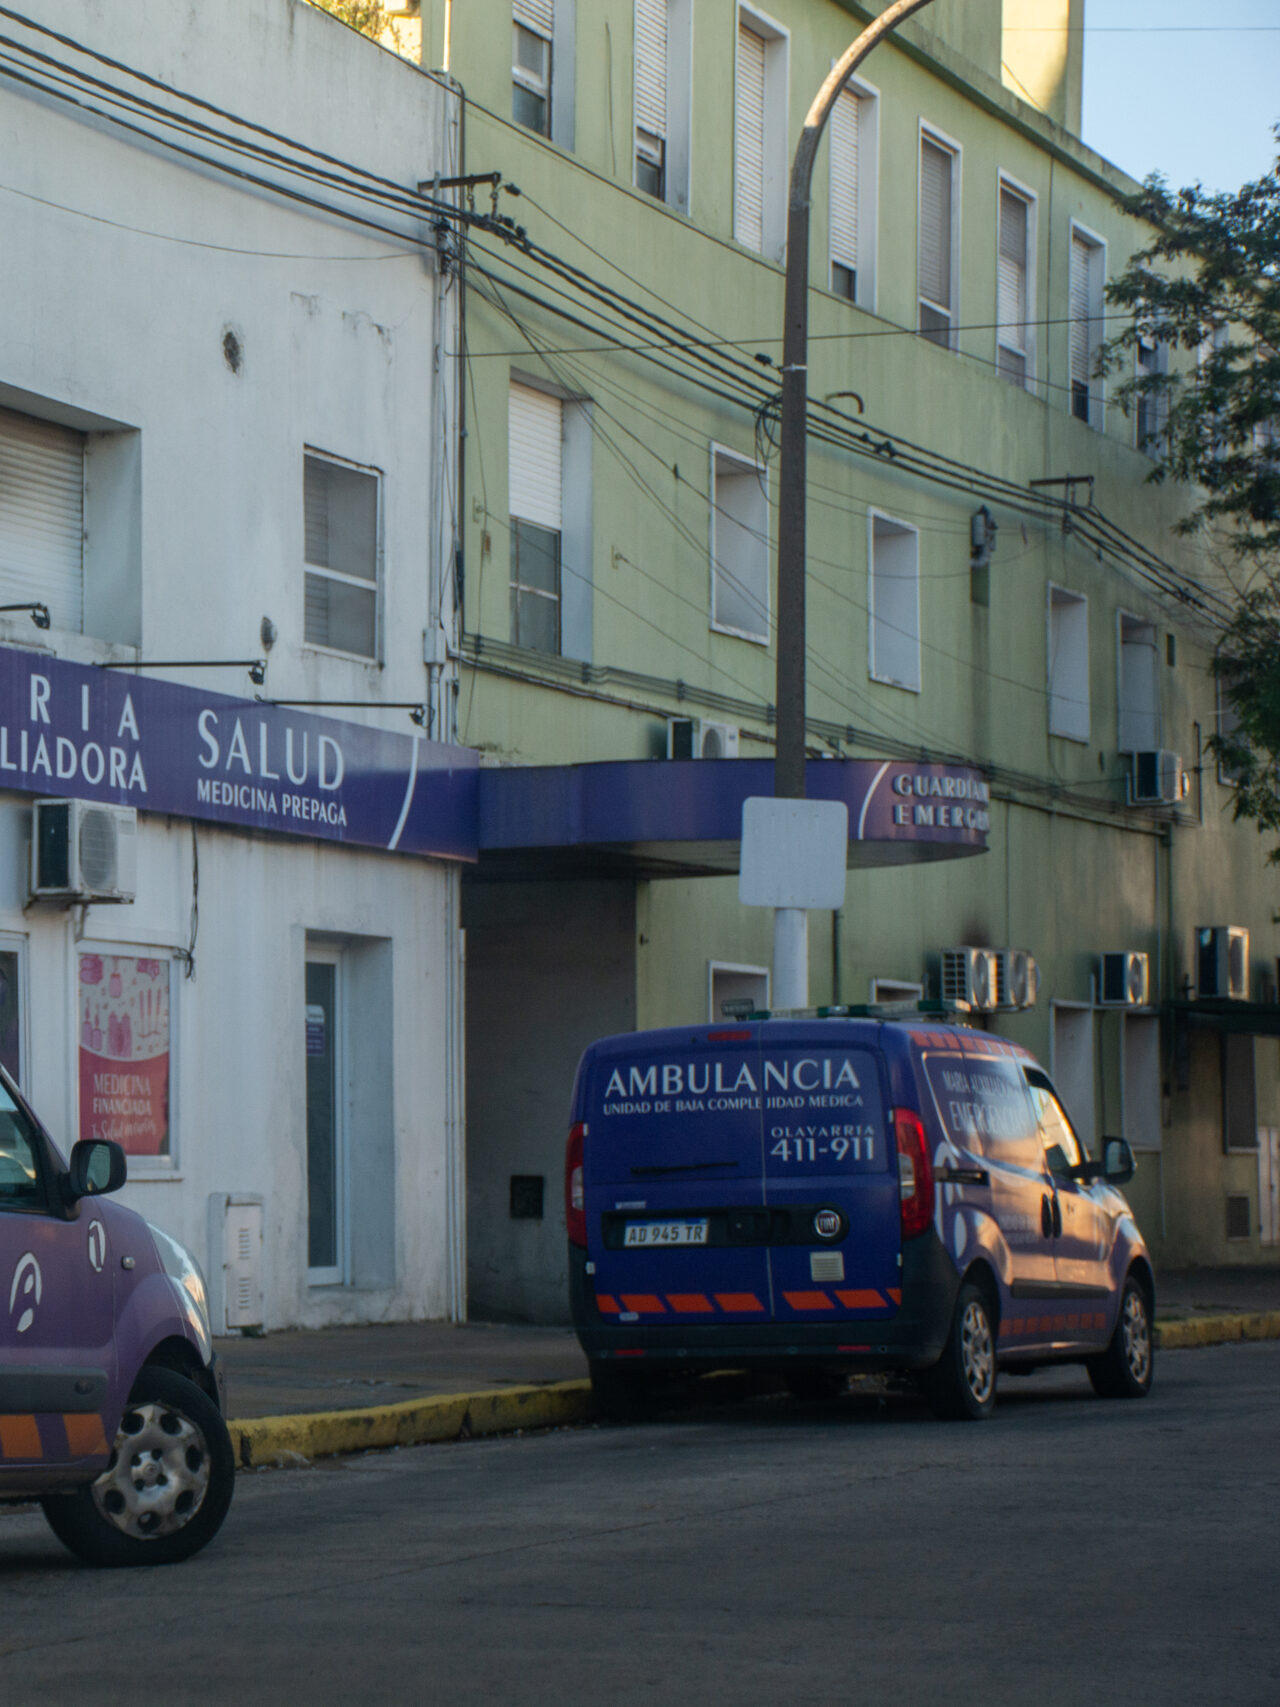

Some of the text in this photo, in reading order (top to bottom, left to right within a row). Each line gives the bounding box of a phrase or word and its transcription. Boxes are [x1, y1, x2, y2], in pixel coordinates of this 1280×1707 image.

[197, 708, 345, 791] SALUD
[197, 777, 348, 827] MEDICINA PREPAGA
[93, 1073, 152, 1096] MEDICINA
[605, 1058, 861, 1099] AMBULANCIA
[603, 1101, 651, 1115] UNIDAD
[654, 1100, 671, 1113] DE
[676, 1099, 705, 1112] BAJA
[809, 1094, 864, 1108] MEDICA
[771, 1125, 875, 1138] OLAVARRIA
[770, 1136, 875, 1162] 411-911
[629, 1225, 703, 1243] AD 945 TR
